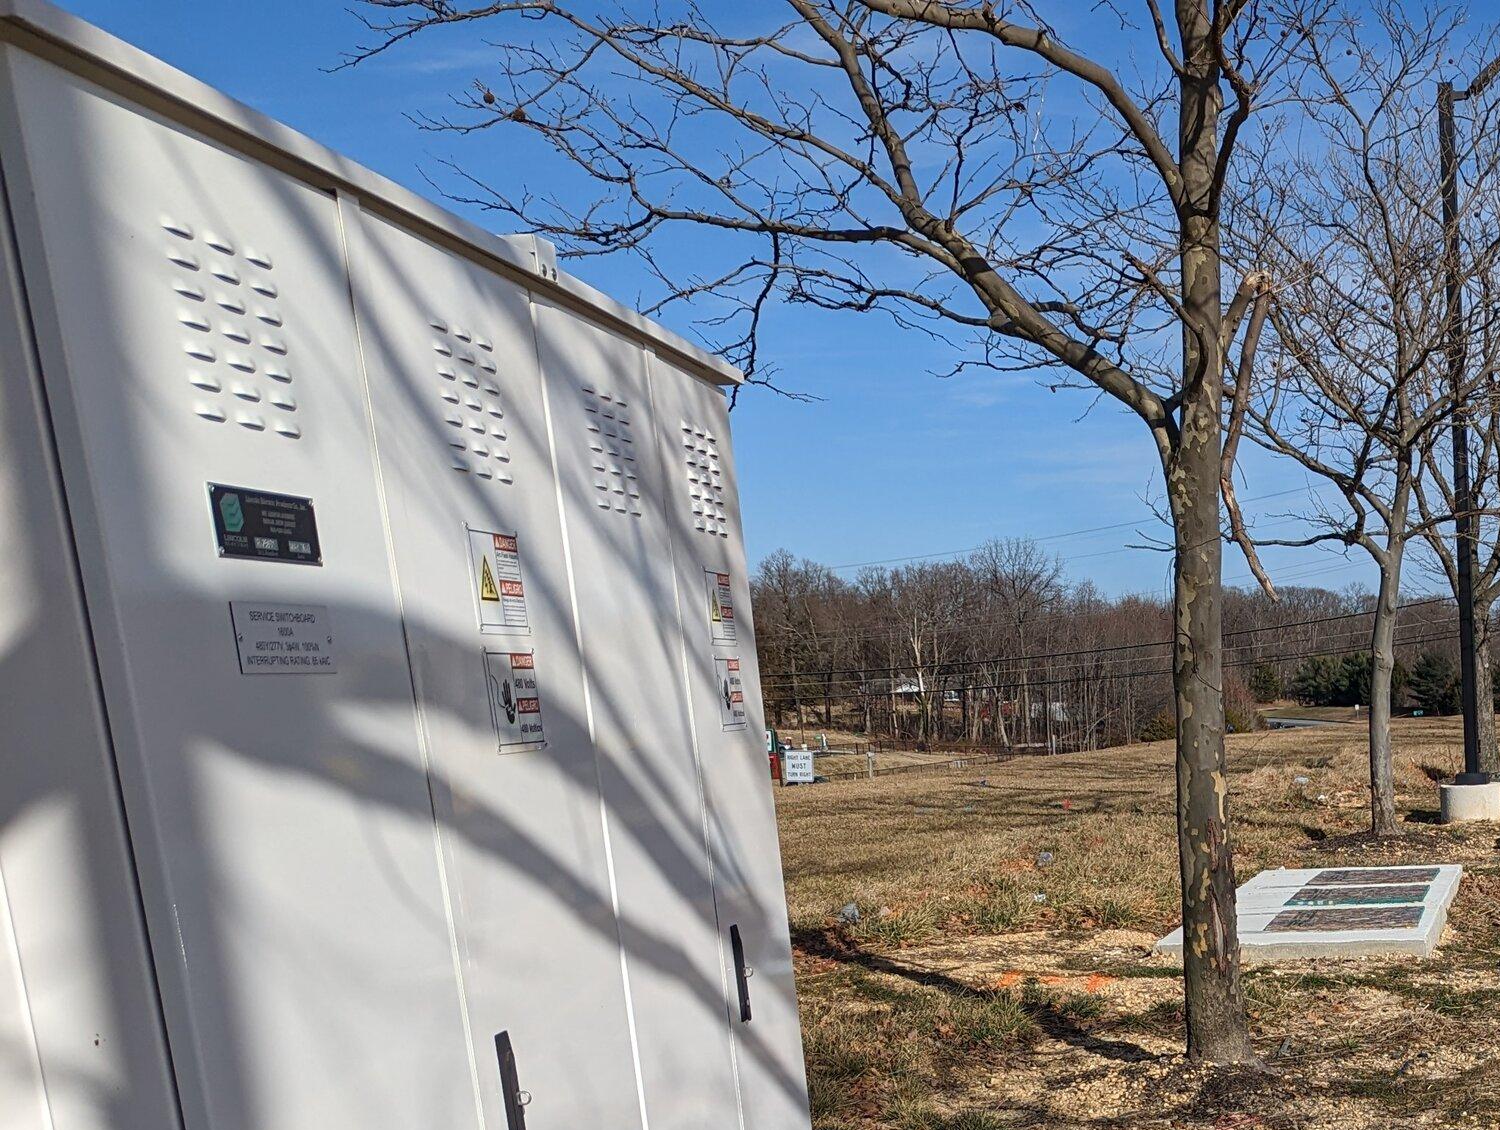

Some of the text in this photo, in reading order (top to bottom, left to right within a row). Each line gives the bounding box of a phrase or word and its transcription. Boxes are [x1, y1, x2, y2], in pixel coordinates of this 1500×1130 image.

[249, 610, 316, 624] SERVICE SWITCHBOARD
[247, 655, 289, 666] INTERRUPTING
[524, 677, 536, 689] Volts
[791, 762, 806, 770] MUST
